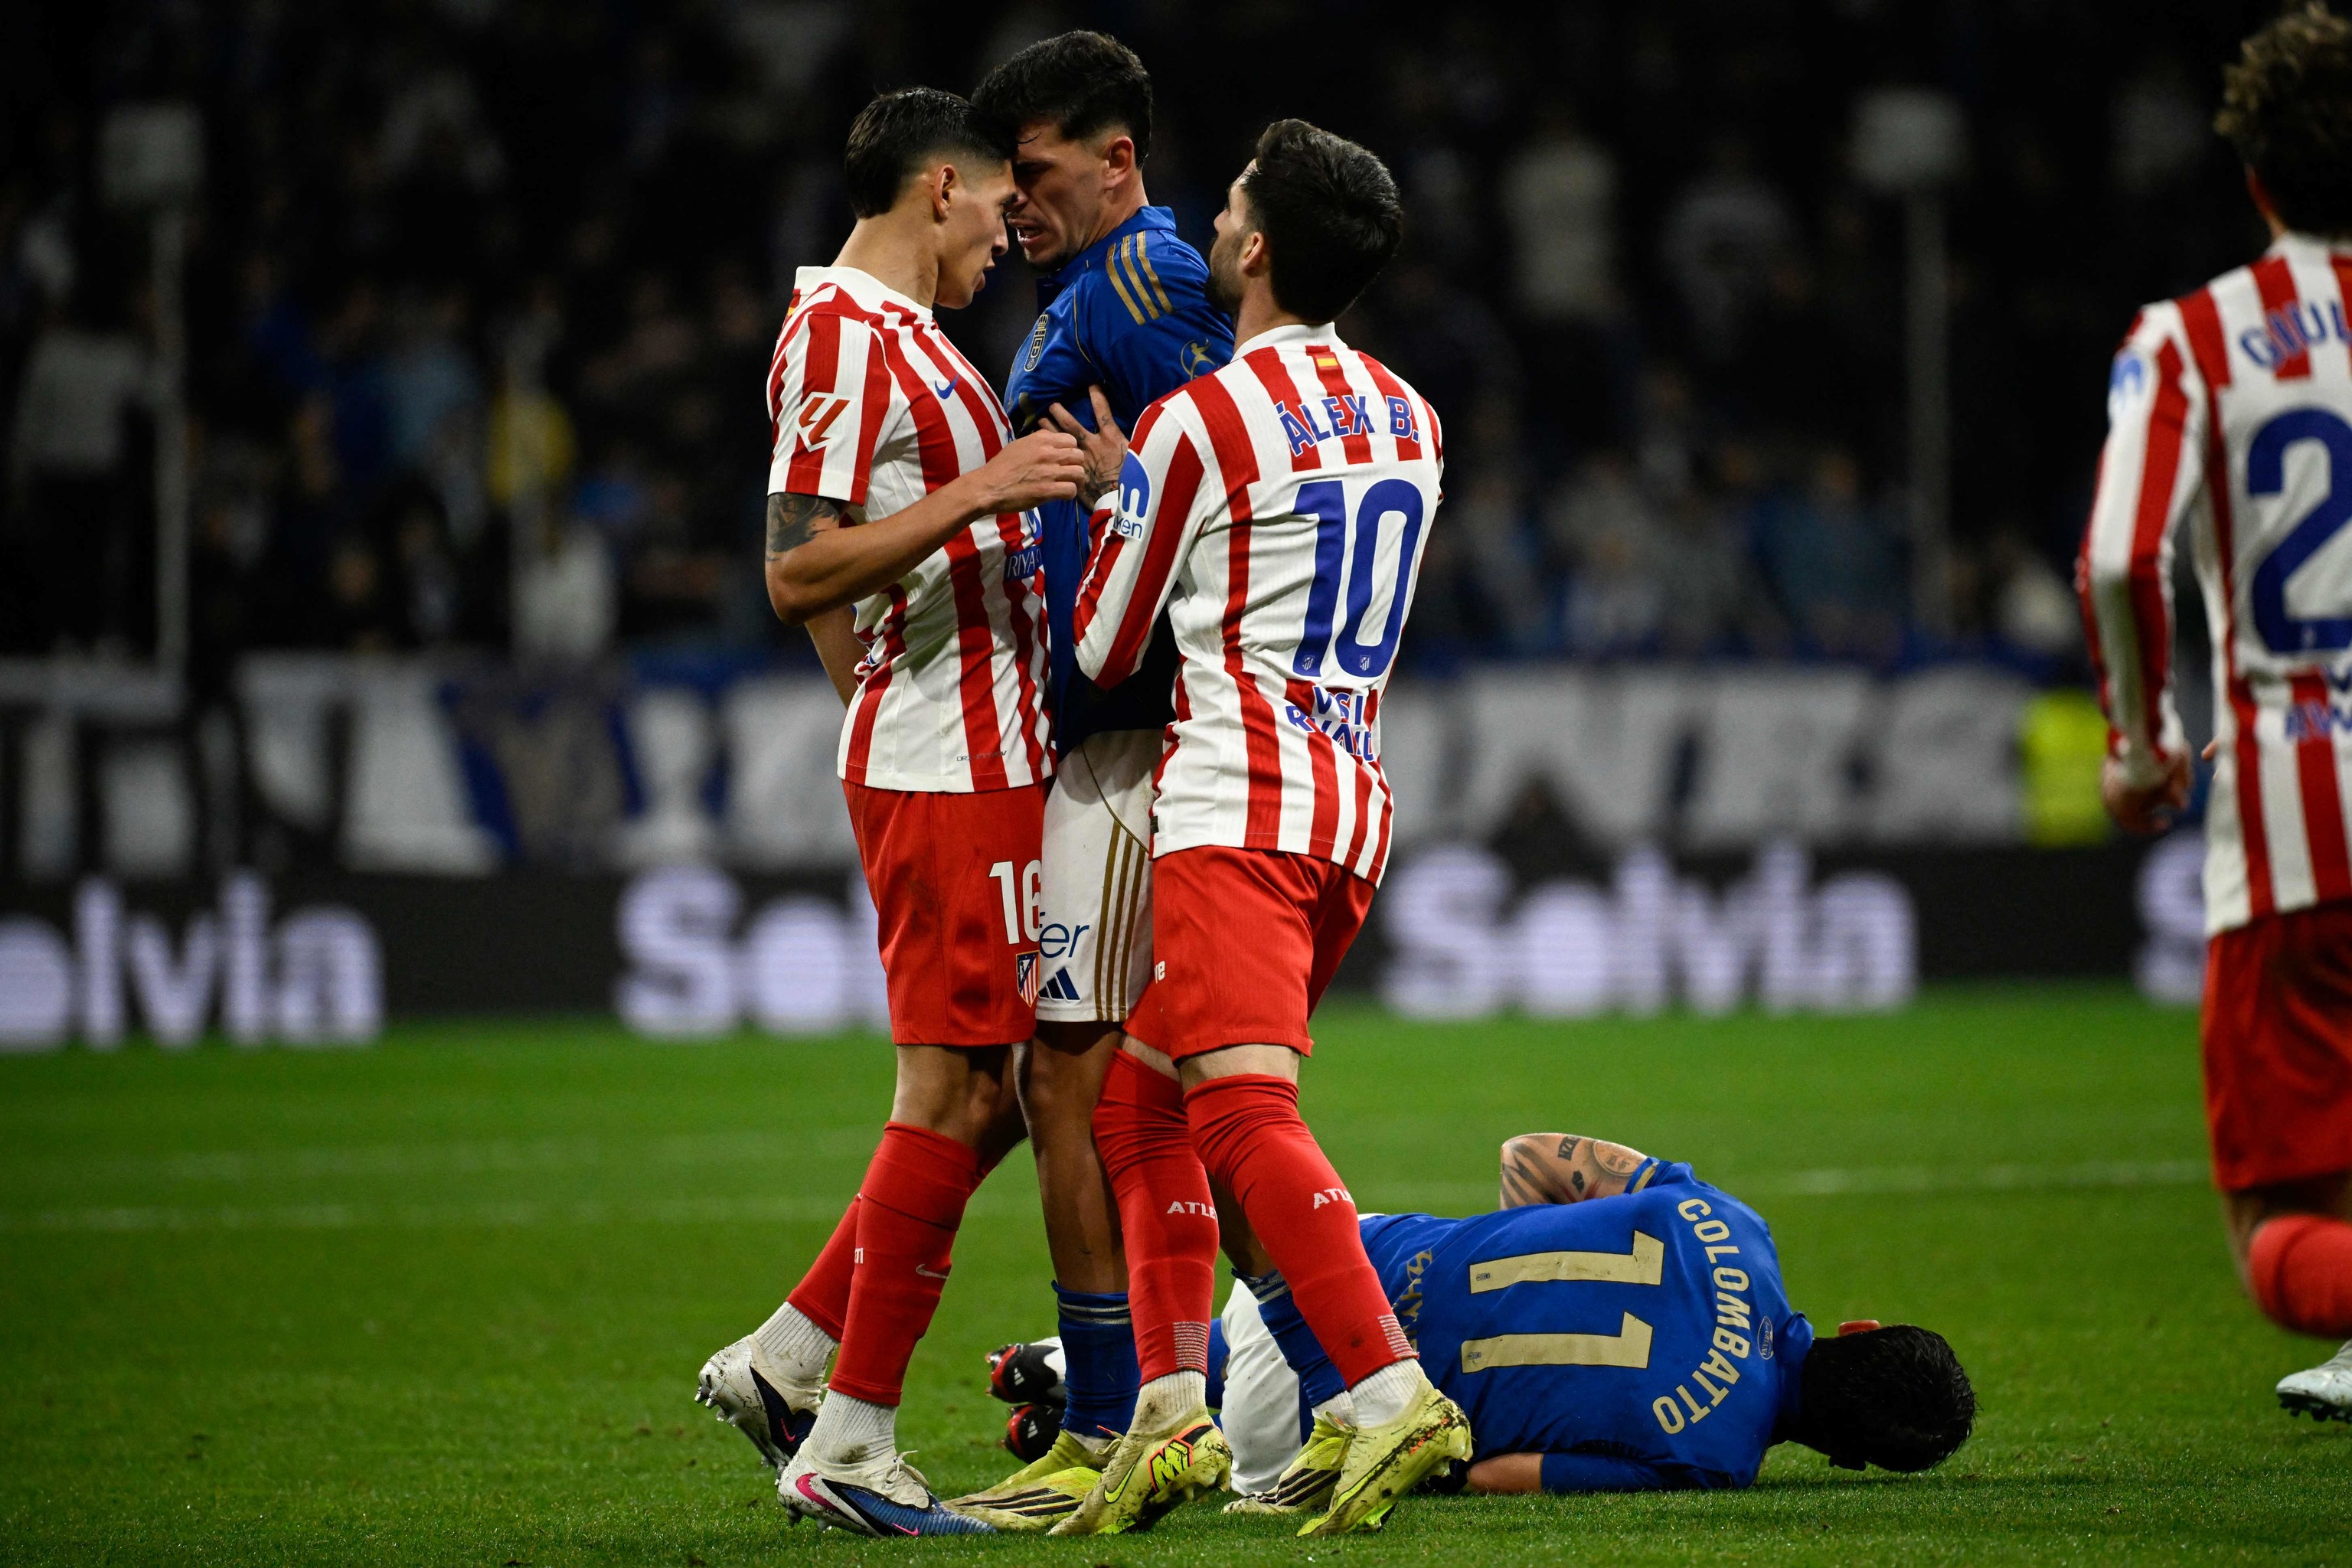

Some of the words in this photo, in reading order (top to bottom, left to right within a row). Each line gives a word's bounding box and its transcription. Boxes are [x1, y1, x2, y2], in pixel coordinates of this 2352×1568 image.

[2239, 299, 2352, 369] GIUL
[1275, 395, 1376, 457] ÁLEX
[1387, 396, 1419, 443] B.
[1292, 479, 1425, 678] 10
[988, 859, 1041, 944] 16
[1039, 911, 1089, 959] er
[1383, 841, 1919, 1020] Solvia
[0, 870, 384, 1050] olvia
[1167, 1200, 1218, 1224] ATLE
[1313, 1188, 1356, 1210] ATLE
[1461, 1230, 1665, 1374] 11
[1652, 1198, 1751, 1435] COLOMBATTO
